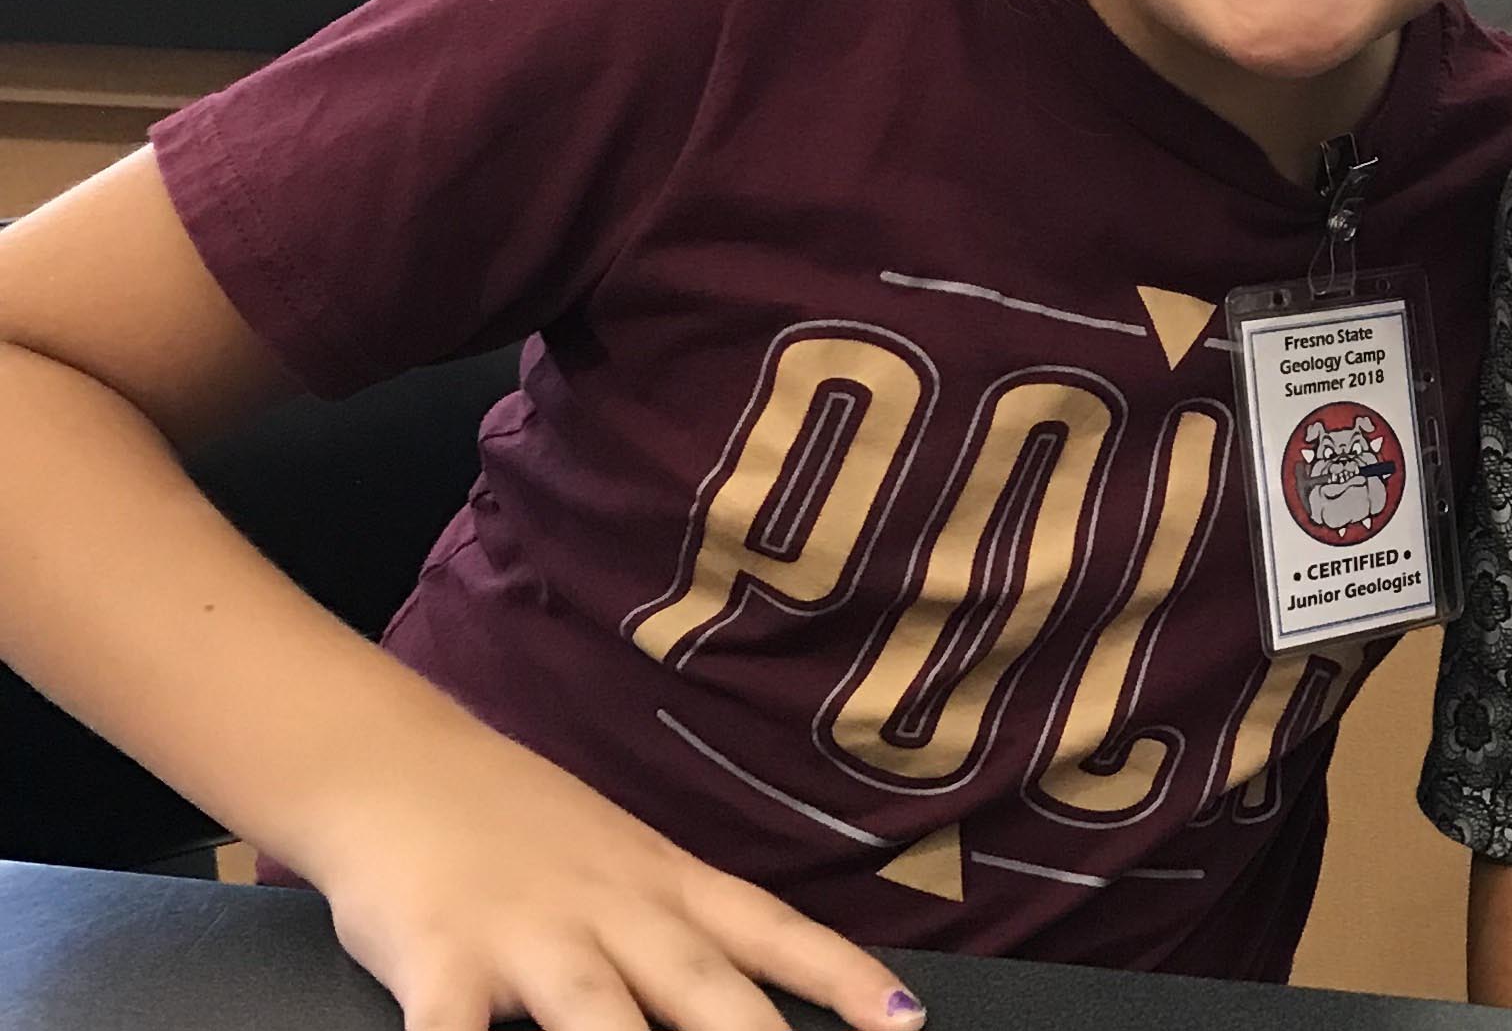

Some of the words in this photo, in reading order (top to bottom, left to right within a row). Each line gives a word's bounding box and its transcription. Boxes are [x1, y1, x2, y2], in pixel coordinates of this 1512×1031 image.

[1284, 332, 1335, 351] Fresno
[1337, 327, 1374, 344] State
[1279, 355, 1342, 374] Geology
[1344, 349, 1386, 366] Camp
[1284, 376, 1346, 397] Summer
[1348, 368, 1385, 388] 2018
[1307, 549, 1399, 581] CERTIFIED
[1287, 588, 1341, 611] Junior
[1344, 570, 1422, 599] Geologist
